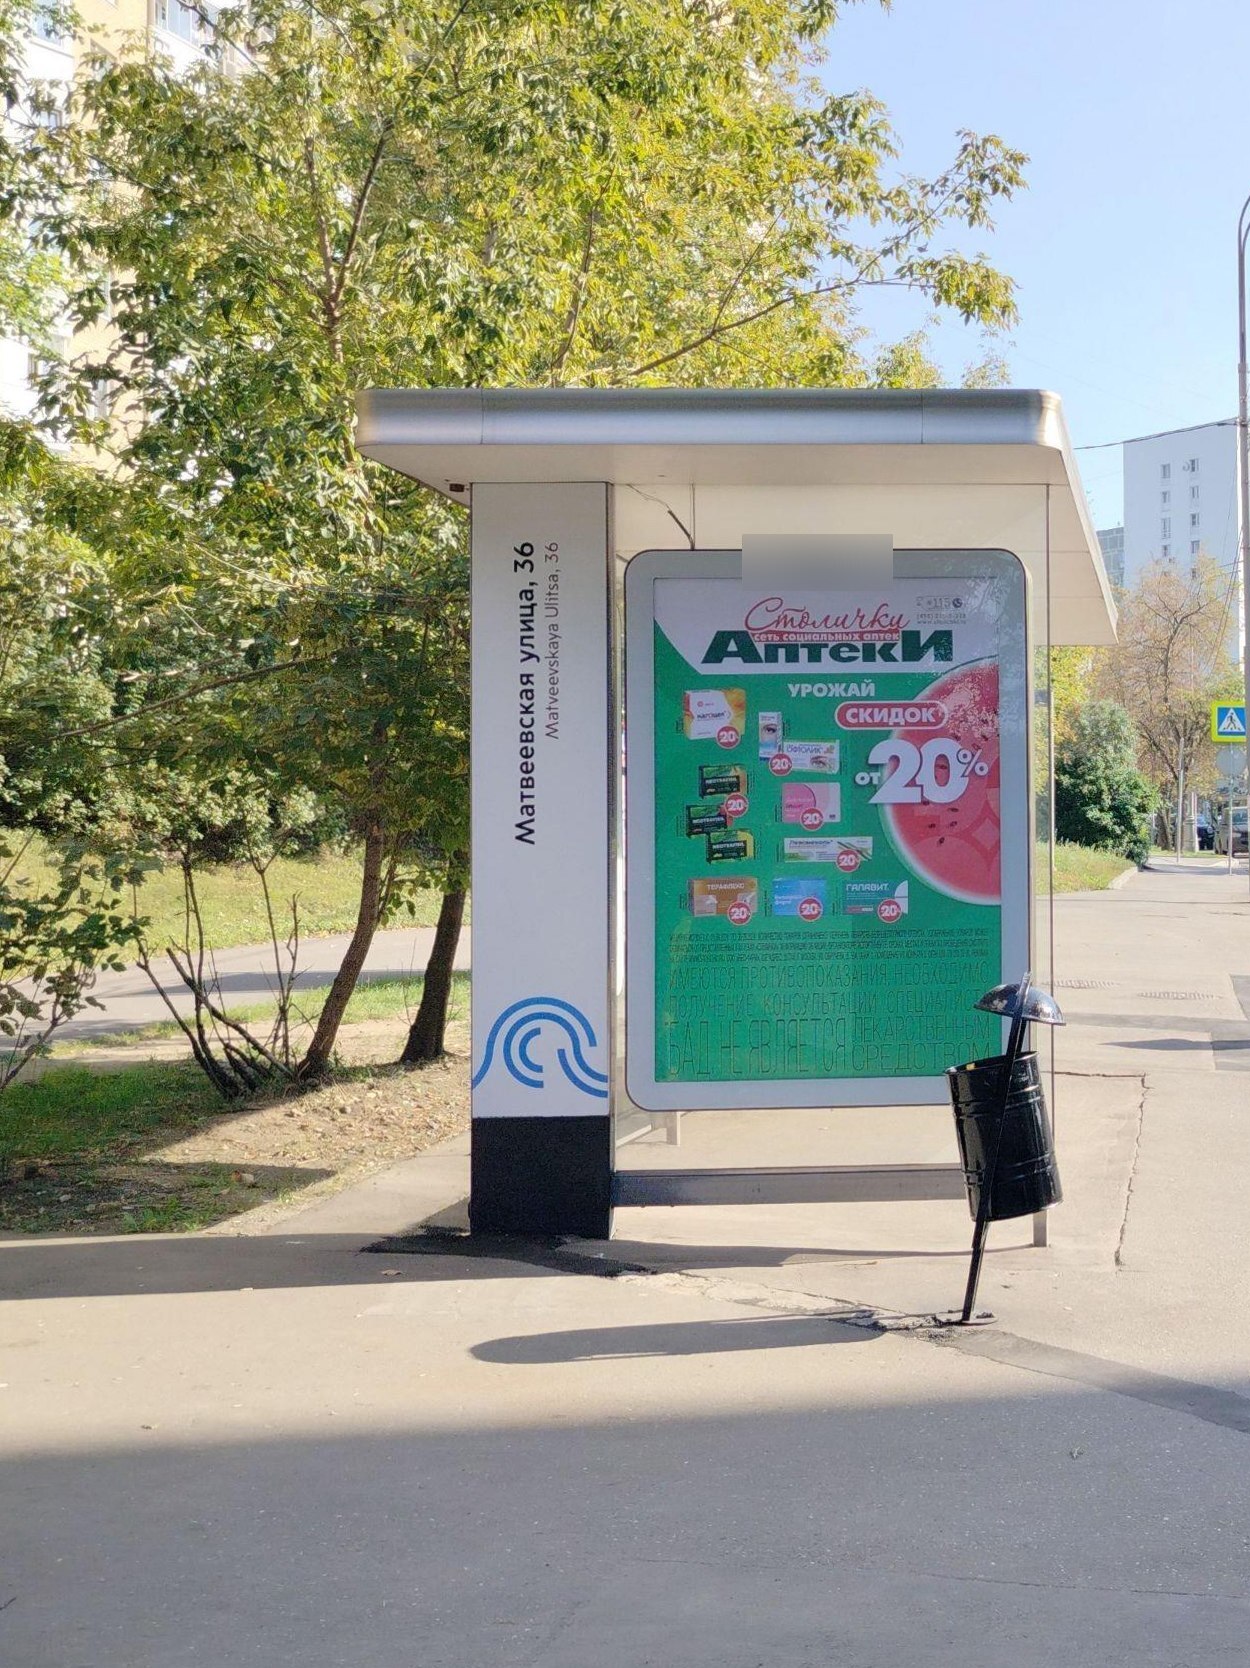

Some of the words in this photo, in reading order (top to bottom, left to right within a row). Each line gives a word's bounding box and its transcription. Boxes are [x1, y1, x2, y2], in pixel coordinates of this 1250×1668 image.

[513, 541, 535, 573] 36
[544, 541, 559, 564] 36
[544, 568, 562, 619] Ulitsa,
[518, 579, 541, 664] улица,
[744, 596, 911, 632] Столички
[753, 631, 780, 642] сеть
[781, 631, 860, 643] социальных
[863, 631, 900, 642] аптек
[545, 623, 563, 740] Matveevskaya
[788, 678, 876, 698] УРОЖАЙ
[845, 706, 937, 726] СКИДОК
[514, 672, 536, 845] Матвеевская
[867, 737, 990, 804] 20%
[855, 771, 881, 786] от
[669, 965, 736, 990] ИМЕЮТСЯ
[894, 961, 989, 986] НЕОБХОДИМО
[669, 993, 753, 1019] ПОЛУЧЕНИЕ
[763, 990, 877, 1017] КОНСУЛЬТАЦИИ
[887, 988, 985, 1014] СПЕЦИАЛИСТ
[669, 1020, 711, 1077] БАД
[719, 1019, 743, 1074] НЕ
[748, 1017, 846, 1074] ЯВЛЯЕТСЯ
[851, 1014, 990, 1043] ЛЕКАРСТВЕННЫМ
